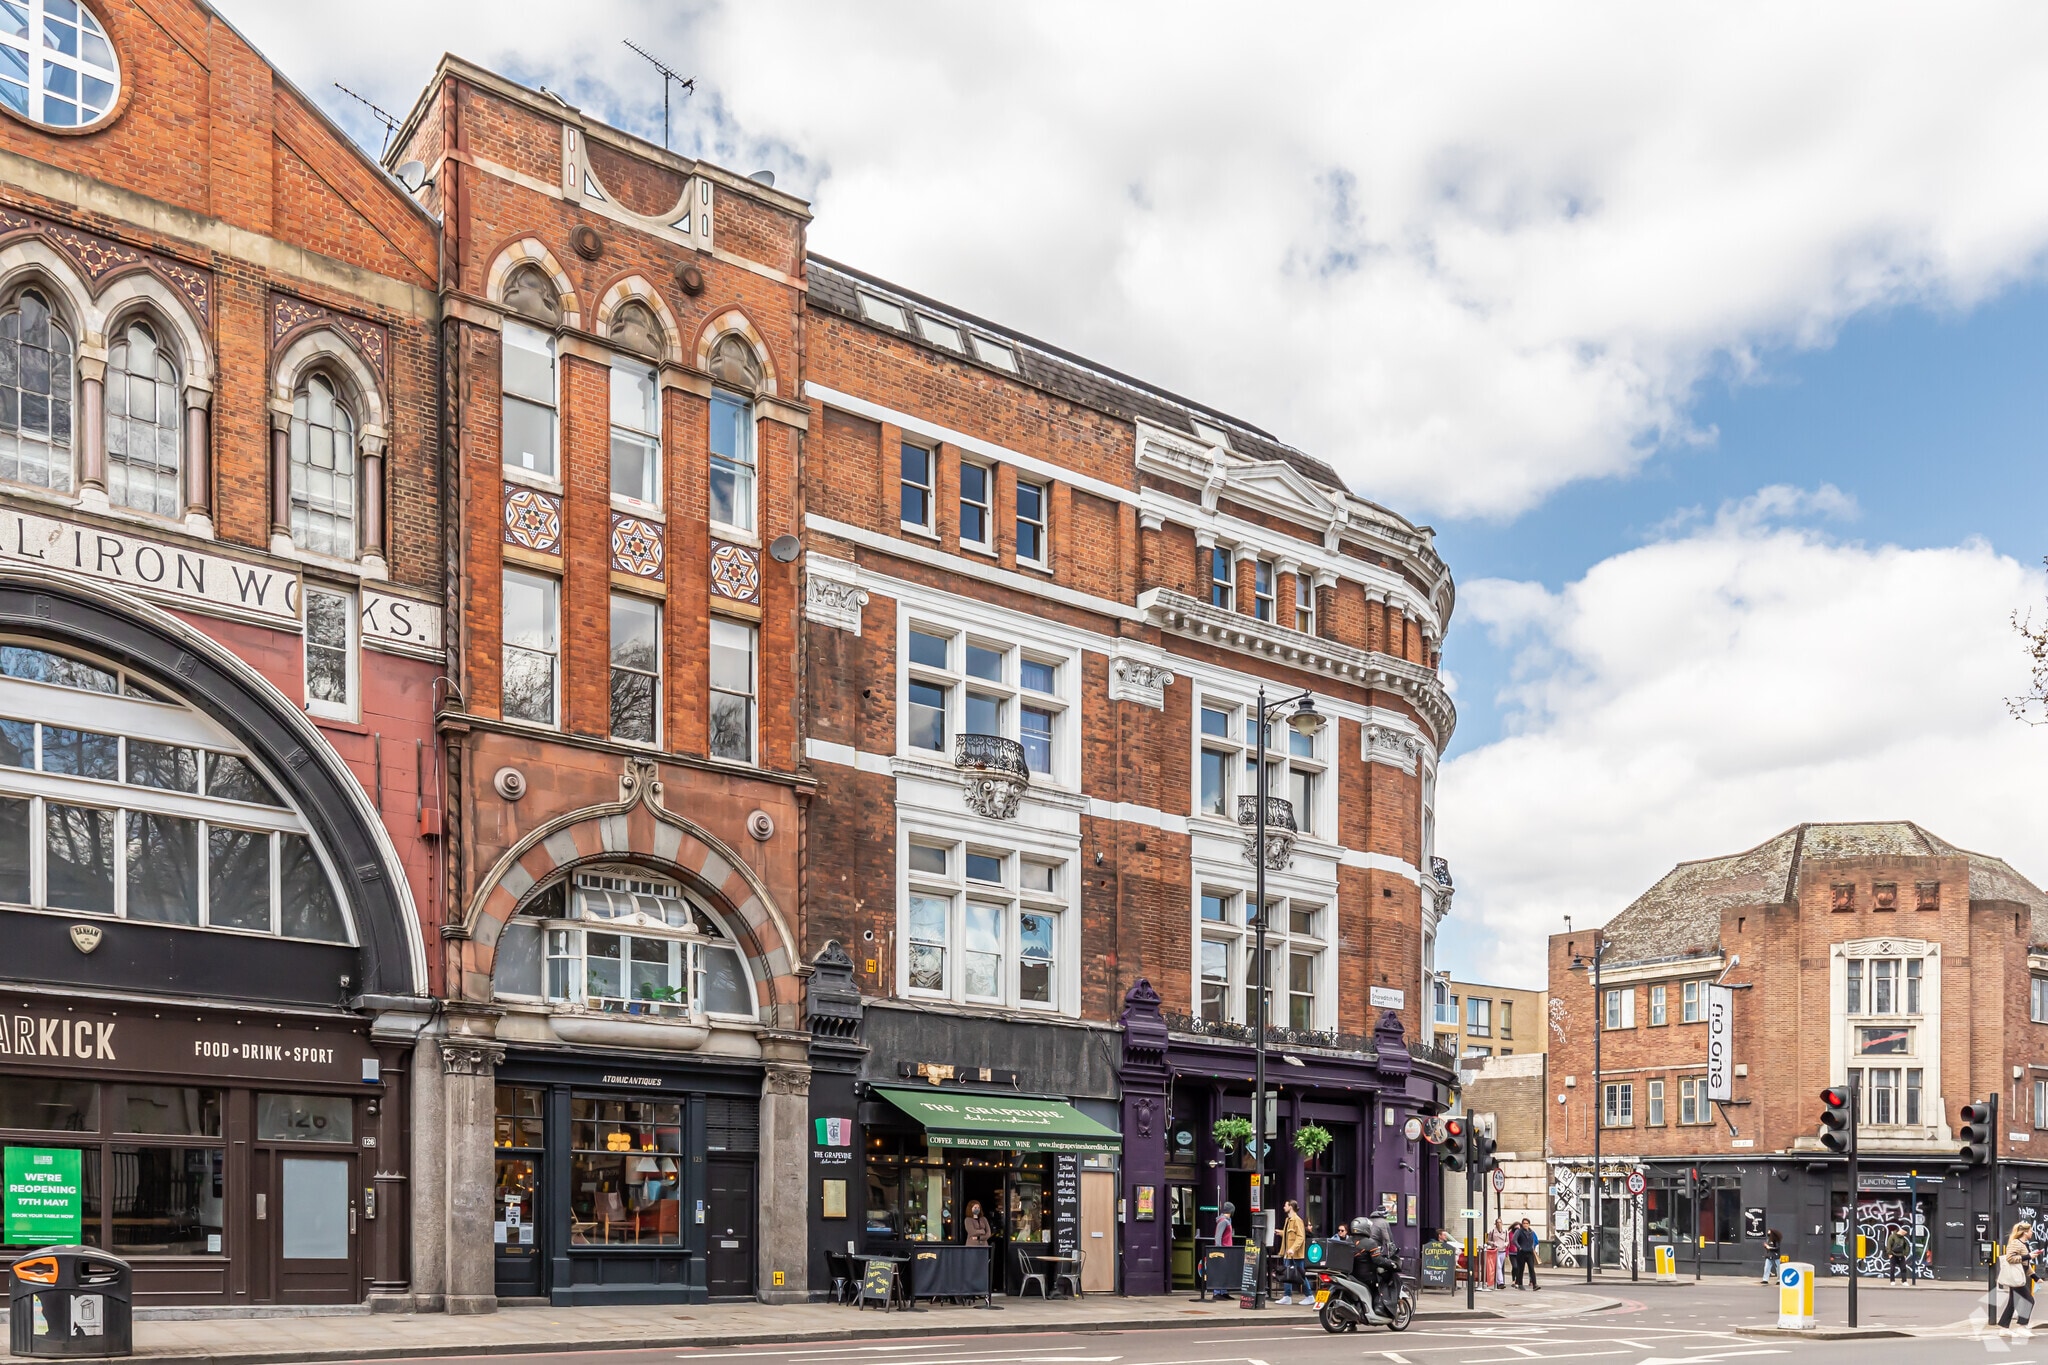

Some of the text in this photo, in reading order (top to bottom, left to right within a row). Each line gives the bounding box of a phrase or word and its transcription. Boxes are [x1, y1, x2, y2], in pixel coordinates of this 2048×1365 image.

[75, 530, 205, 594] IRON
[867, 959, 875, 972] H
[920, 1102, 1064, 1119] THE GRAPEVINE
[929, 1136, 953, 1145] COFFEE
[957, 1138, 989, 1147] BREAKFAST
[993, 1139, 1011, 1147] PASTA
[1015, 1140, 1031, 1148] WINE
[813, 1151, 852, 1160] THE GRAPEVINE
[24, 1173, 62, 1182] WE'RE
[9, 1184, 77, 1194] REOPENING
[17, 1198, 69, 1207] 17TH MAY!
[774, 1272, 783, 1285] H
